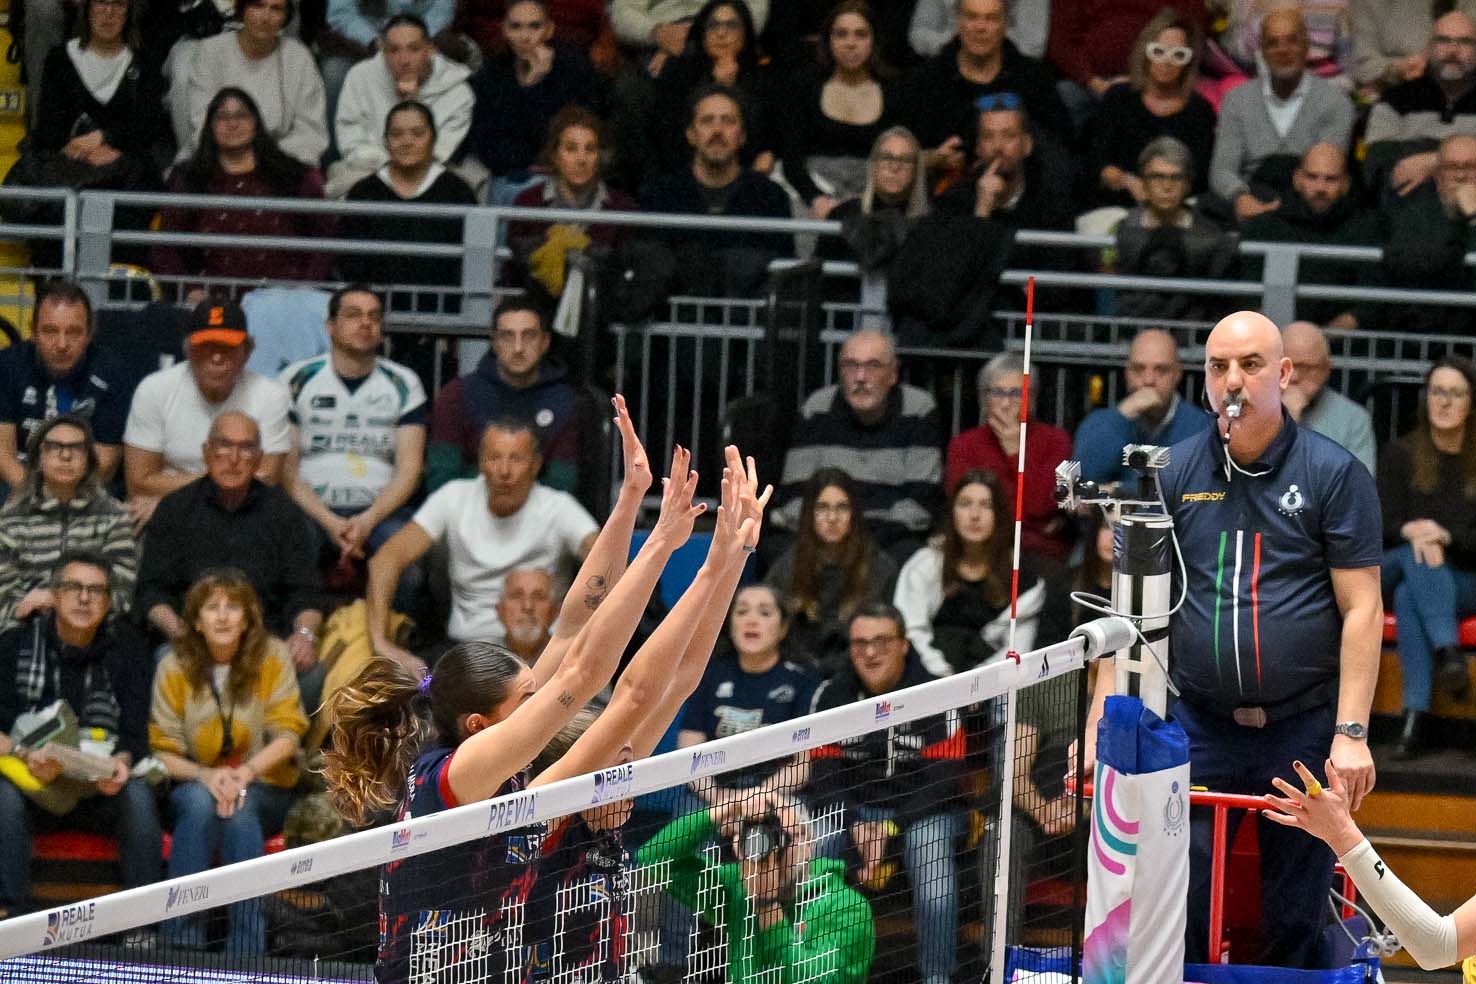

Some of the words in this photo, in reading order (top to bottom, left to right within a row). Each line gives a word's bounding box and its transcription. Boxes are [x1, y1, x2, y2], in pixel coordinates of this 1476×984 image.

[1182, 490, 1226, 503] FREDDY
[606, 764, 633, 784] REALE
[487, 794, 536, 831] PREVIA
[61, 902, 96, 926] REALE
[58, 923, 92, 942] MUTUA
